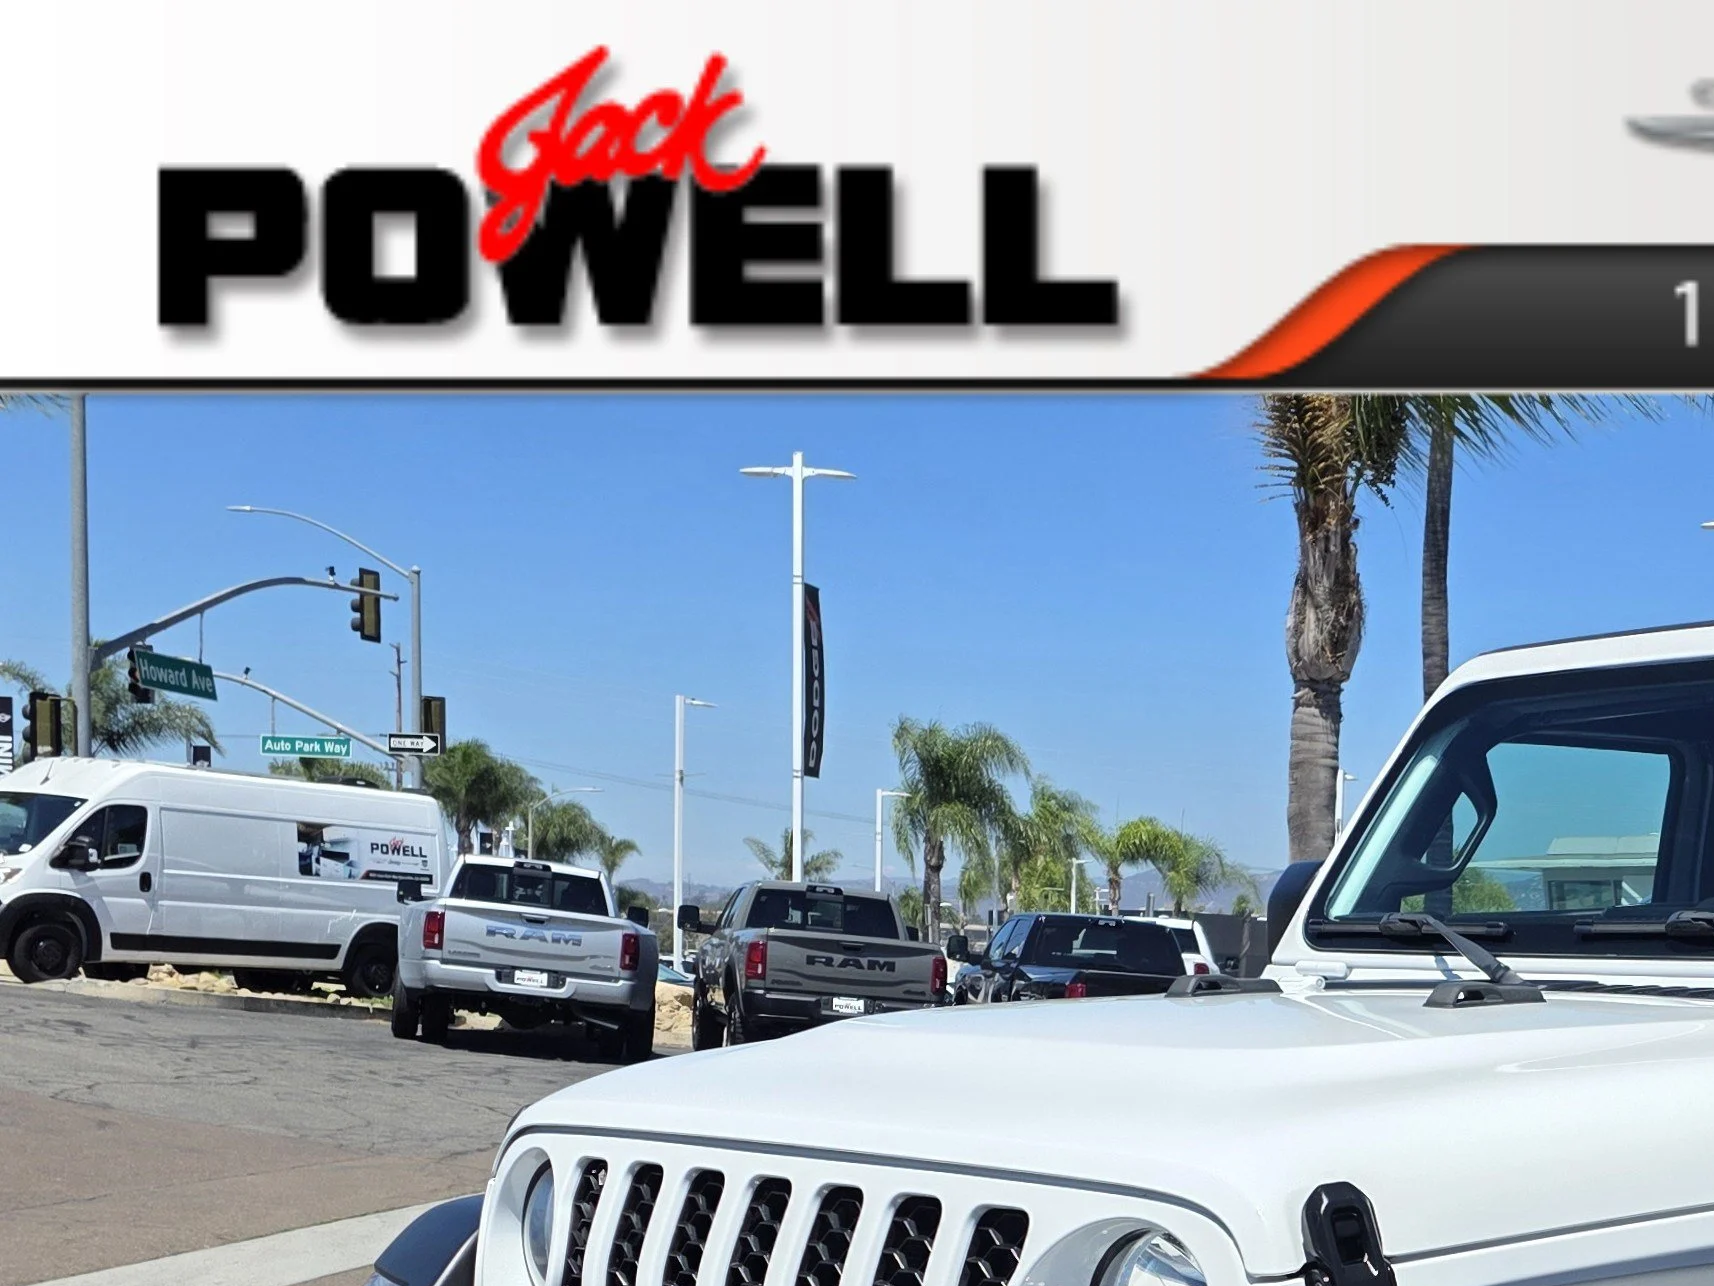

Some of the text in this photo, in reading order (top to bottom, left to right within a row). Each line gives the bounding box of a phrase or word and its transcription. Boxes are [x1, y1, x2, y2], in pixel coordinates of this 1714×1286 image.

[139, 658, 214, 693] Howard Ave
[264, 739, 348, 755] Auto Park Way
[370, 842, 428, 859] POWELL
[486, 925, 583, 947] RAM
[806, 955, 896, 973] RAM
